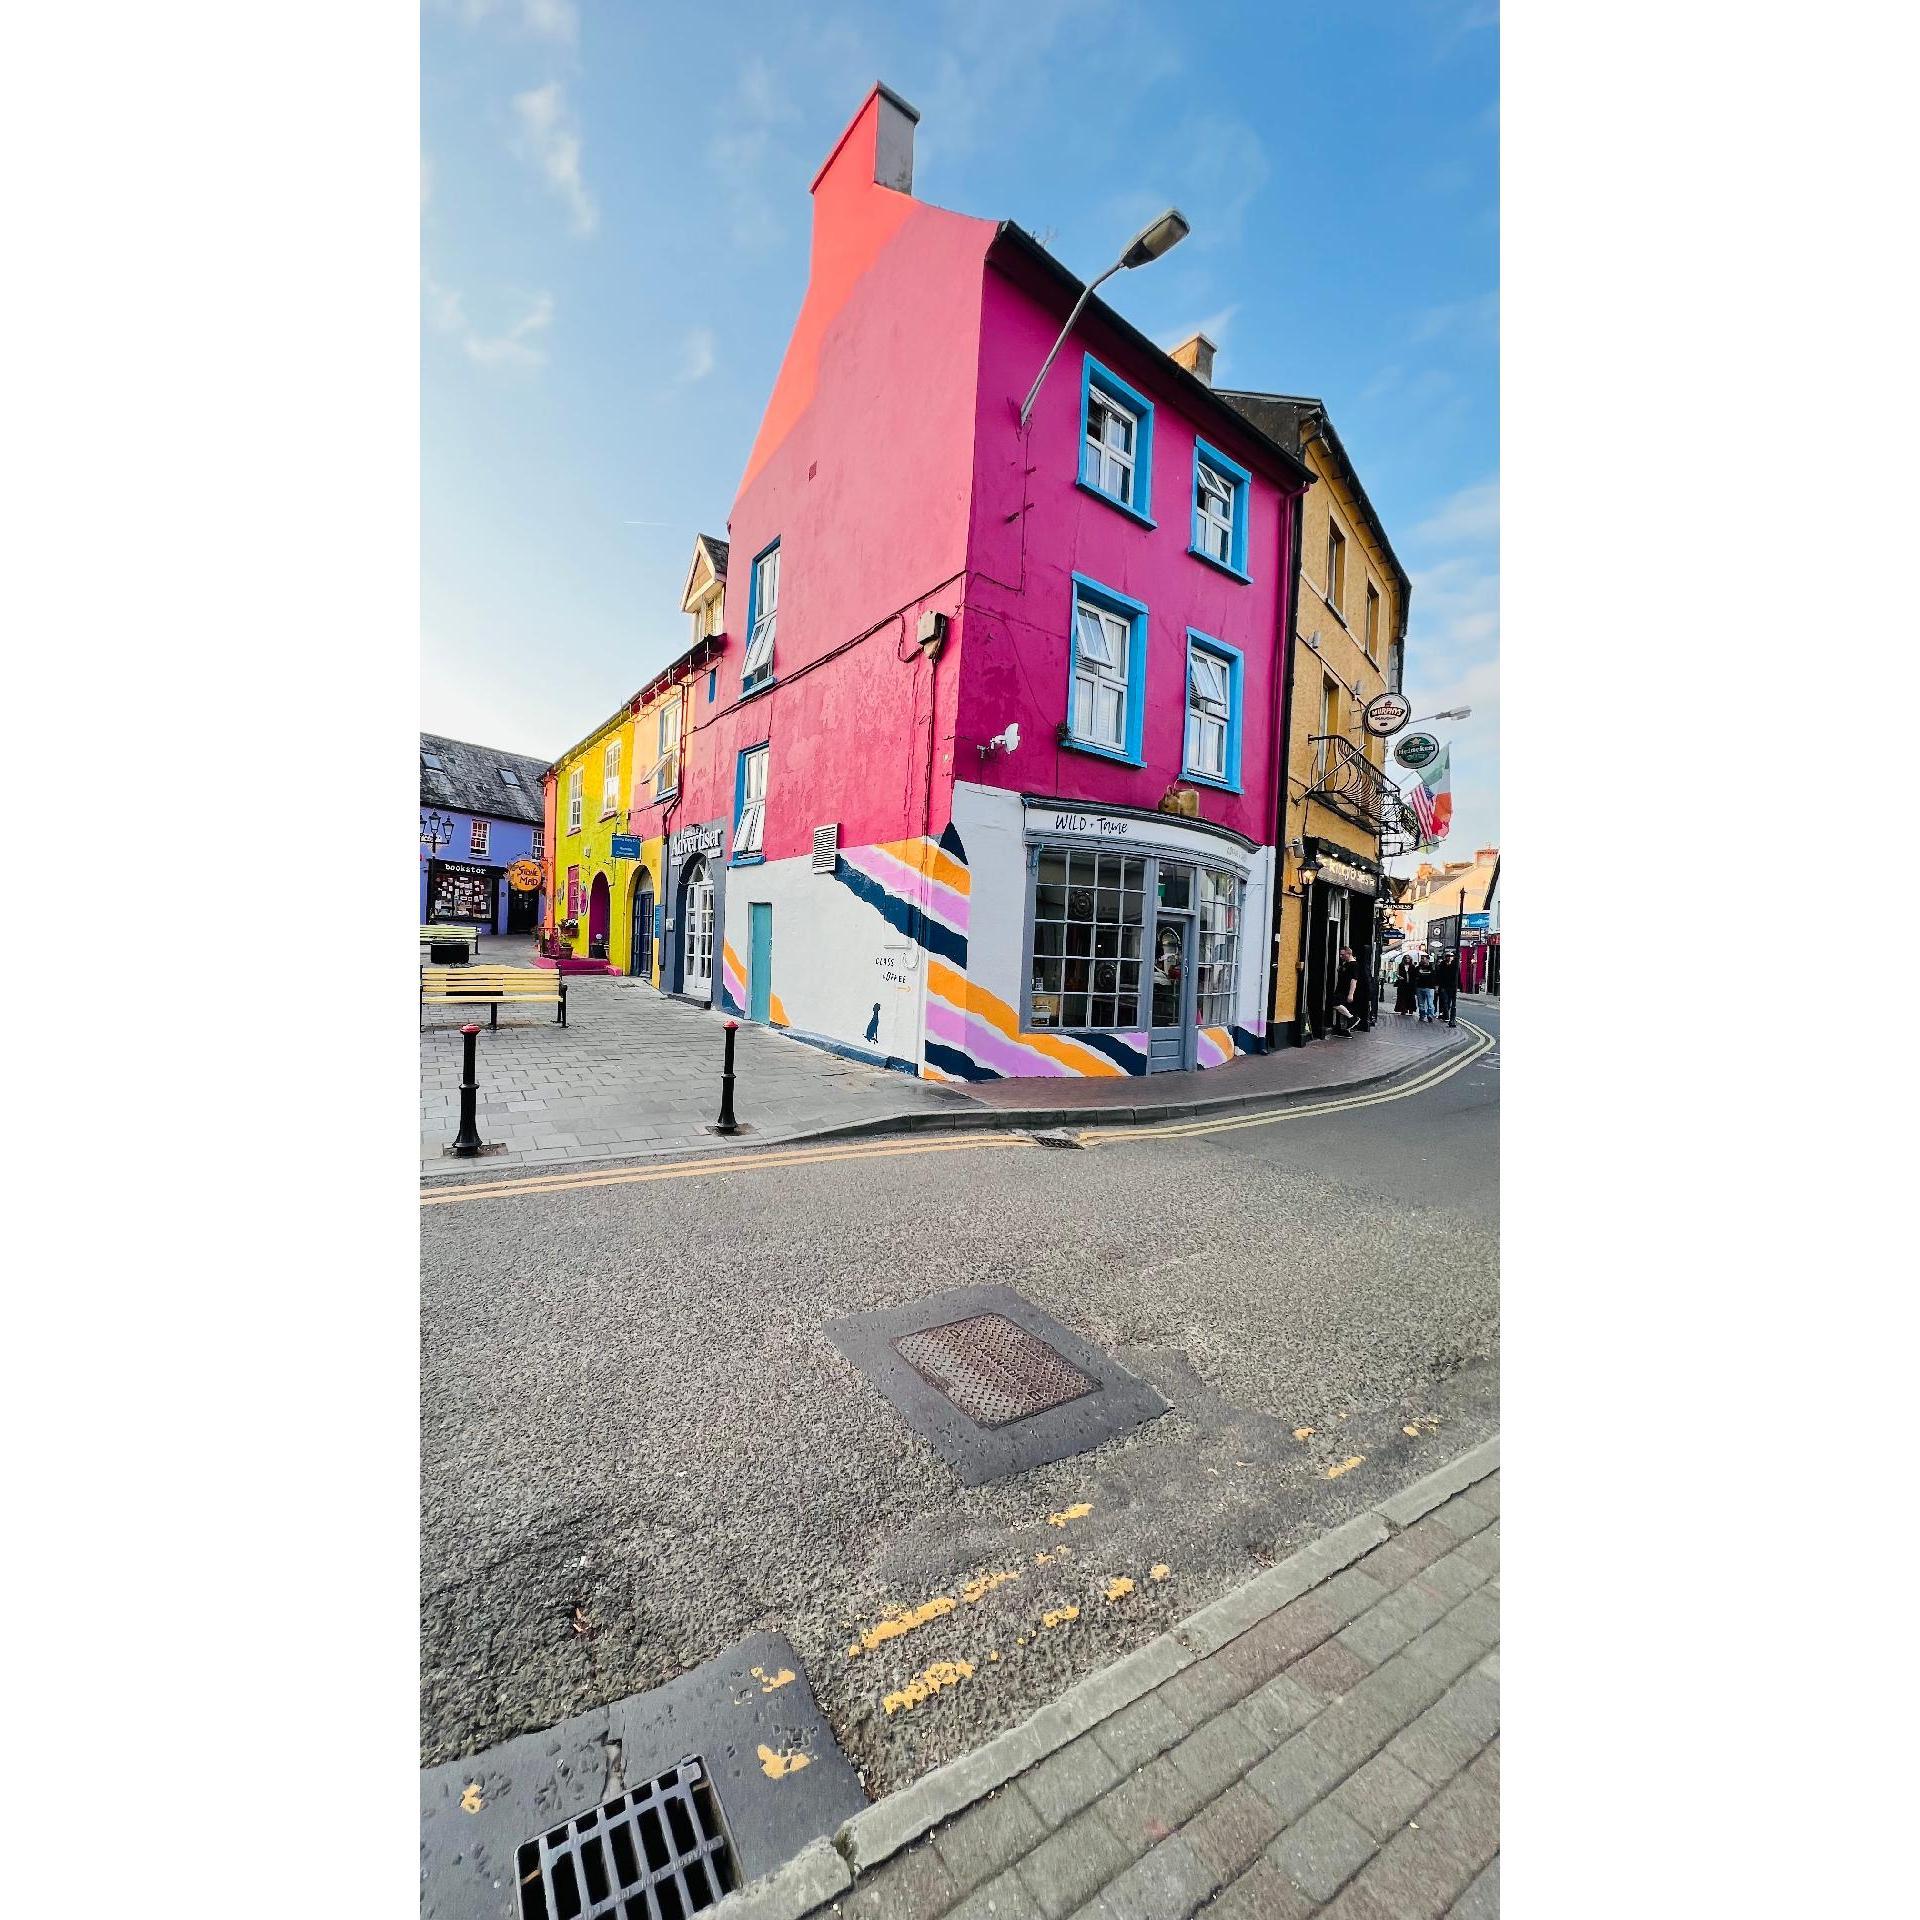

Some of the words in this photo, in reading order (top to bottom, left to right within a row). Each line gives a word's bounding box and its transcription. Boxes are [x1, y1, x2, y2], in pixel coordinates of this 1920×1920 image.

[1056, 814, 1087, 831] WILD
[672, 827, 721, 856] Advertiser
[445, 863, 487, 874] bookstor
